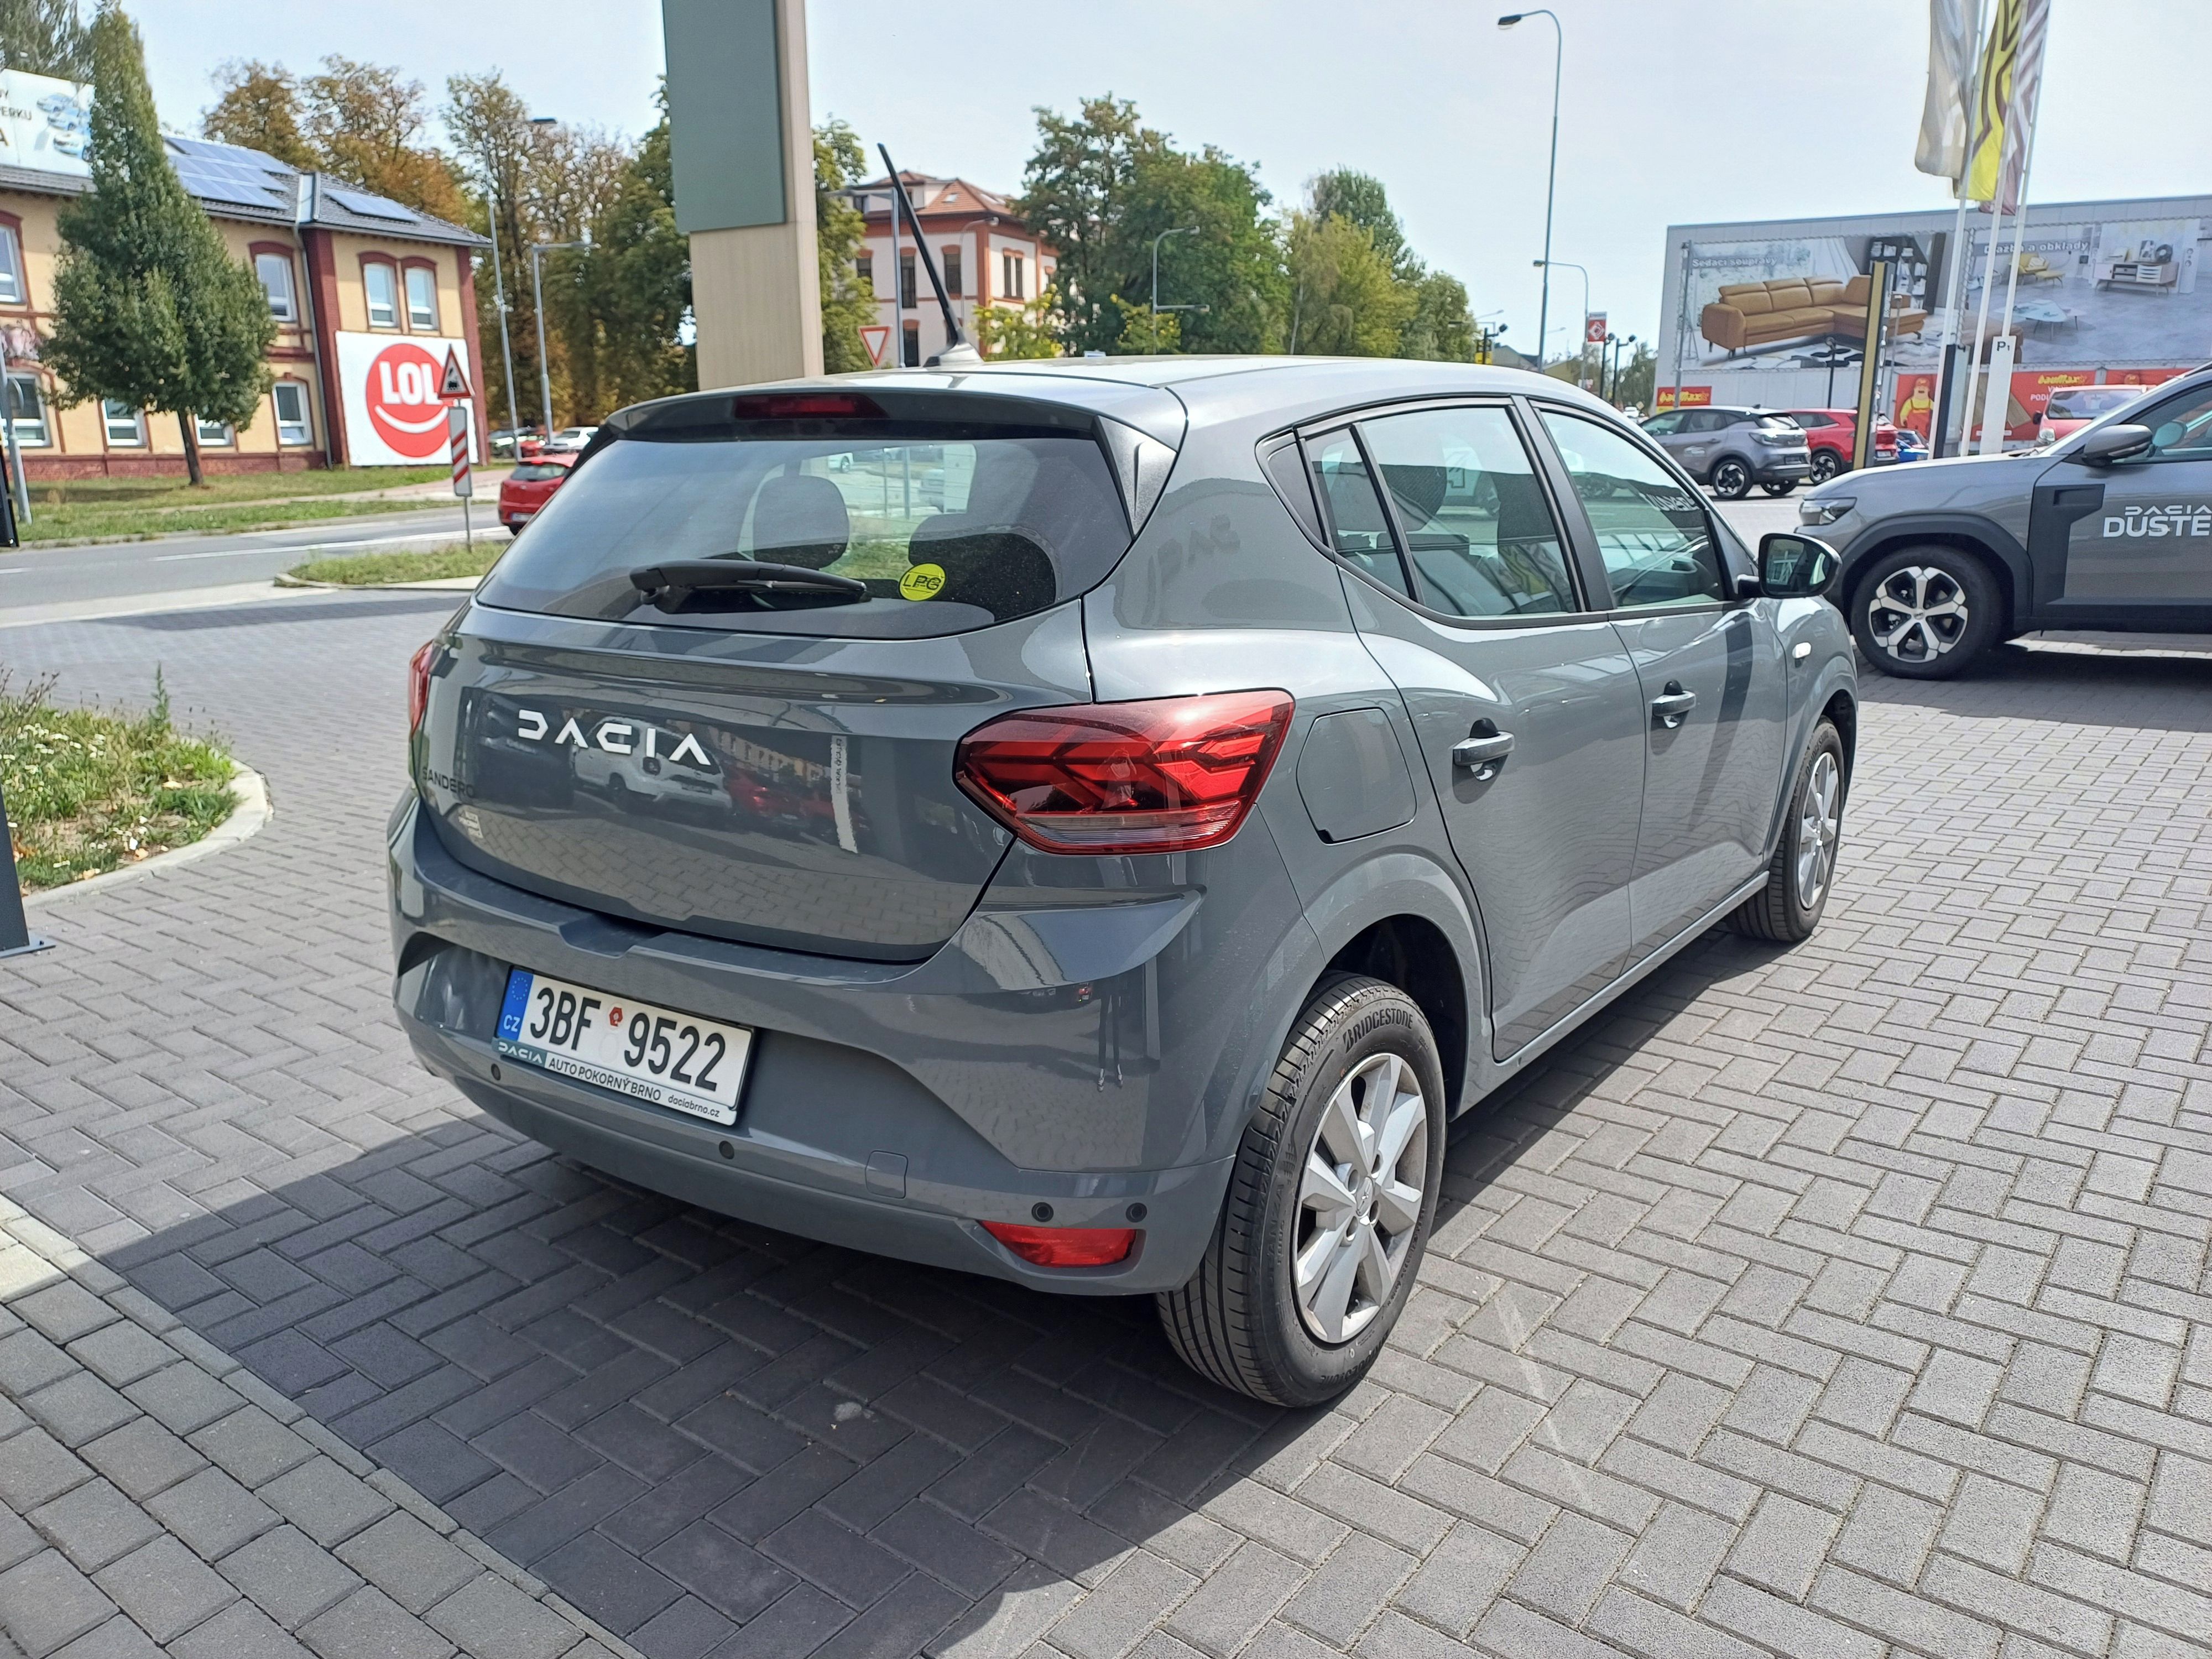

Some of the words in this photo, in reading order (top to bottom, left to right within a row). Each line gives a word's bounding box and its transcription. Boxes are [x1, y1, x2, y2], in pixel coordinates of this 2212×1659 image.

[2039, 241, 2088, 251] obklady
[379, 361, 442, 405] LOL
[2125, 504, 2212, 515] DACIA
[902, 574, 942, 591] LPG
[518, 709, 711, 766] DACIA
[422, 767, 474, 799] SANDERO
[503, 1014, 521, 1032] CZ
[1343, 1008, 1413, 1054] BRIDGESTONE
[498, 1041, 543, 1064] DACIA
[530, 987, 602, 1051] 3BF
[624, 1013, 726, 1092] 9522
[549, 1057, 577, 1075] AUTO
[578, 1066, 630, 1091] POKORNÝ
[630, 1083, 661, 1100] BRNO
[668, 1095, 720, 1118] daciabrno.cz
